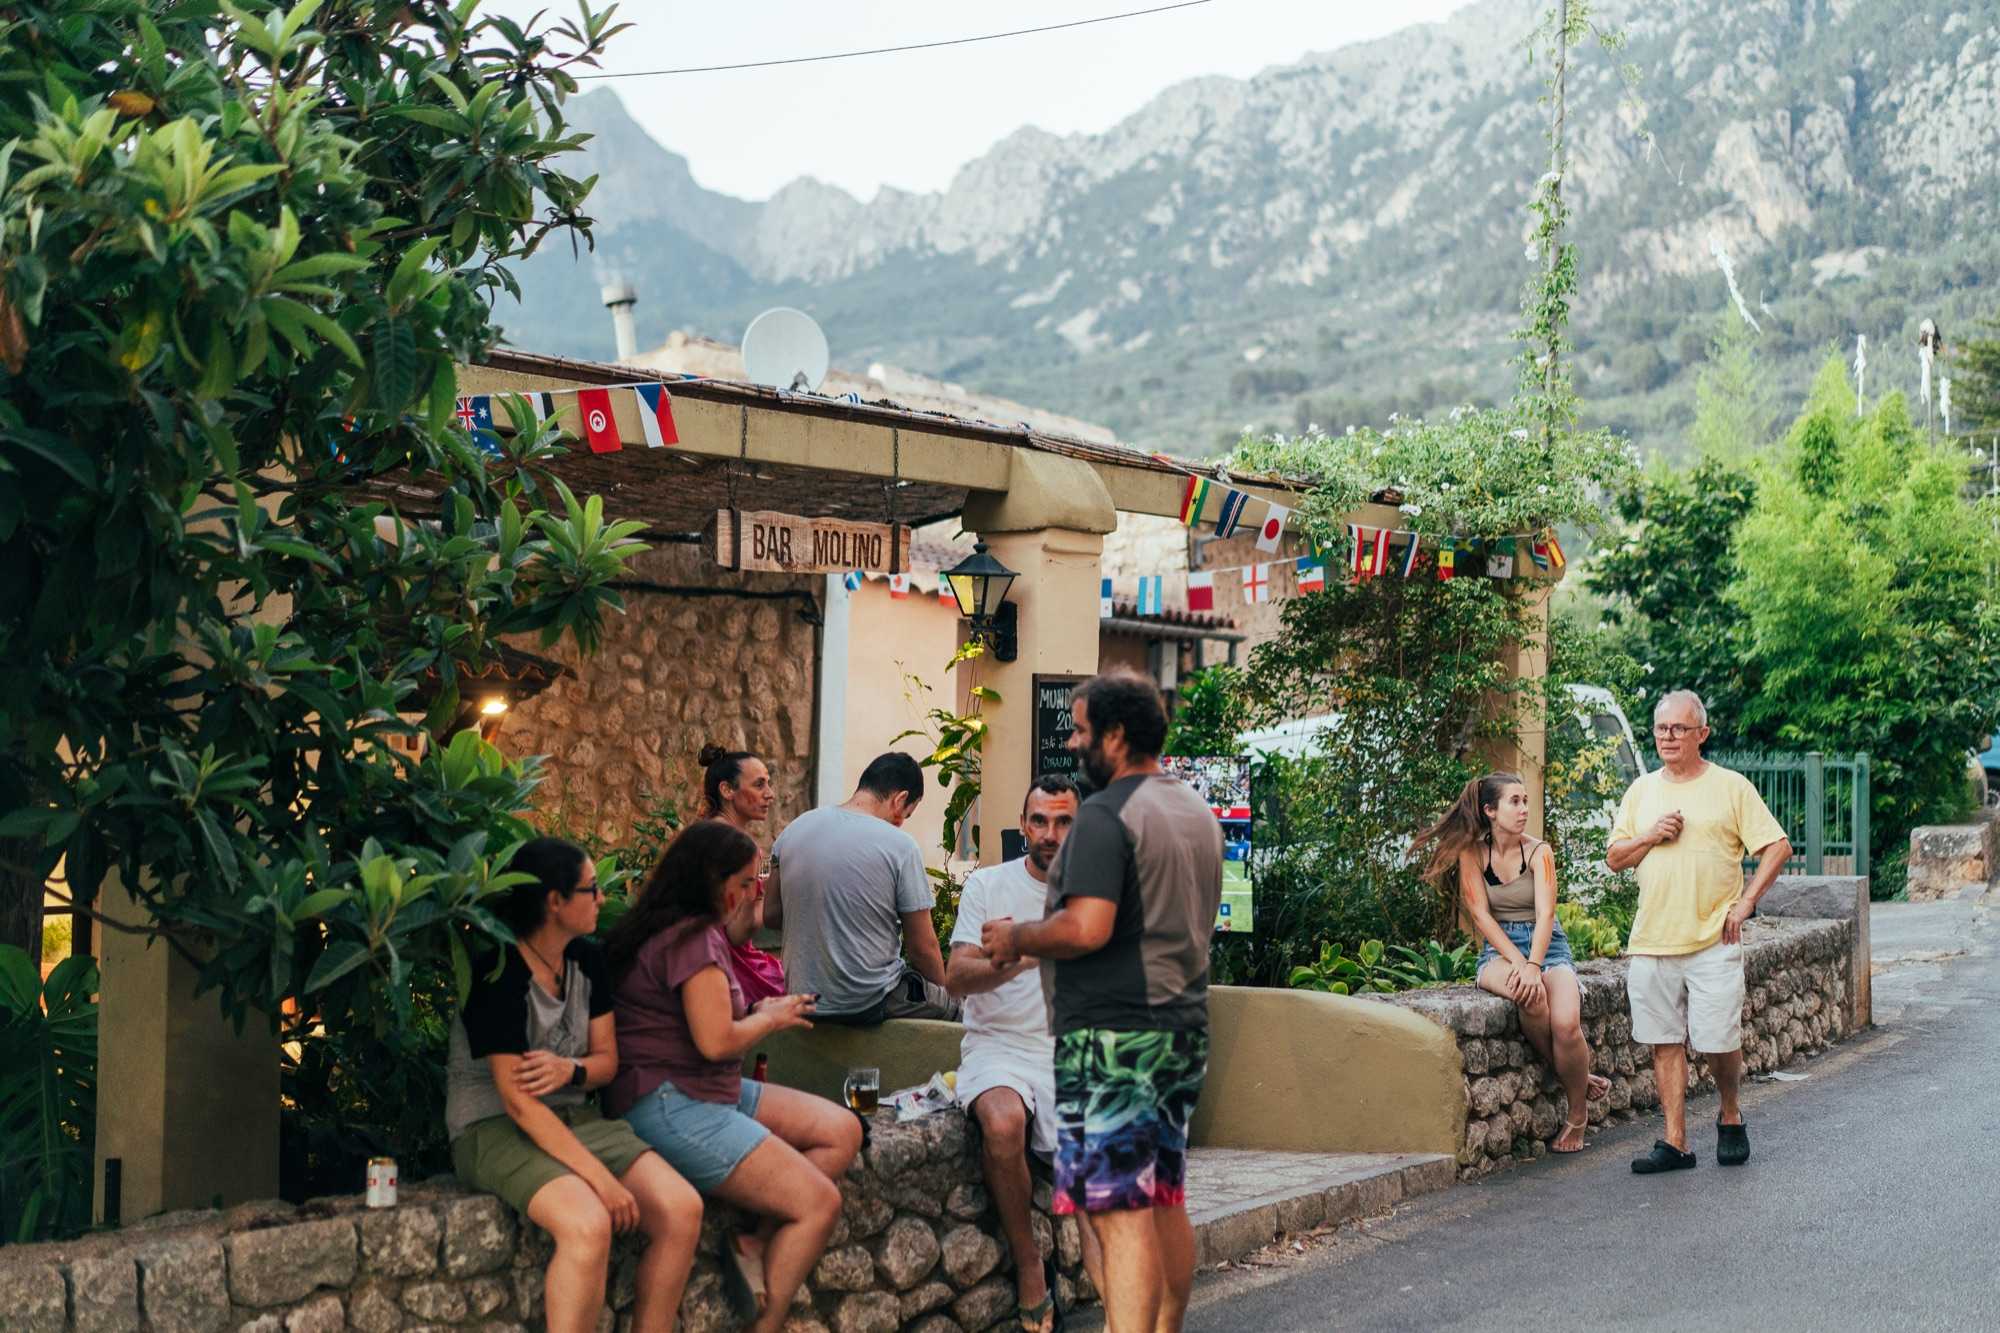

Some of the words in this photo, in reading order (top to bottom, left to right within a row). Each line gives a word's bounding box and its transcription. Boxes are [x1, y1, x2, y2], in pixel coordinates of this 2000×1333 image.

[753, 524, 793, 563] BAR
[813, 529, 882, 568] MOLINO
[1039, 688, 1071, 710] MUND
